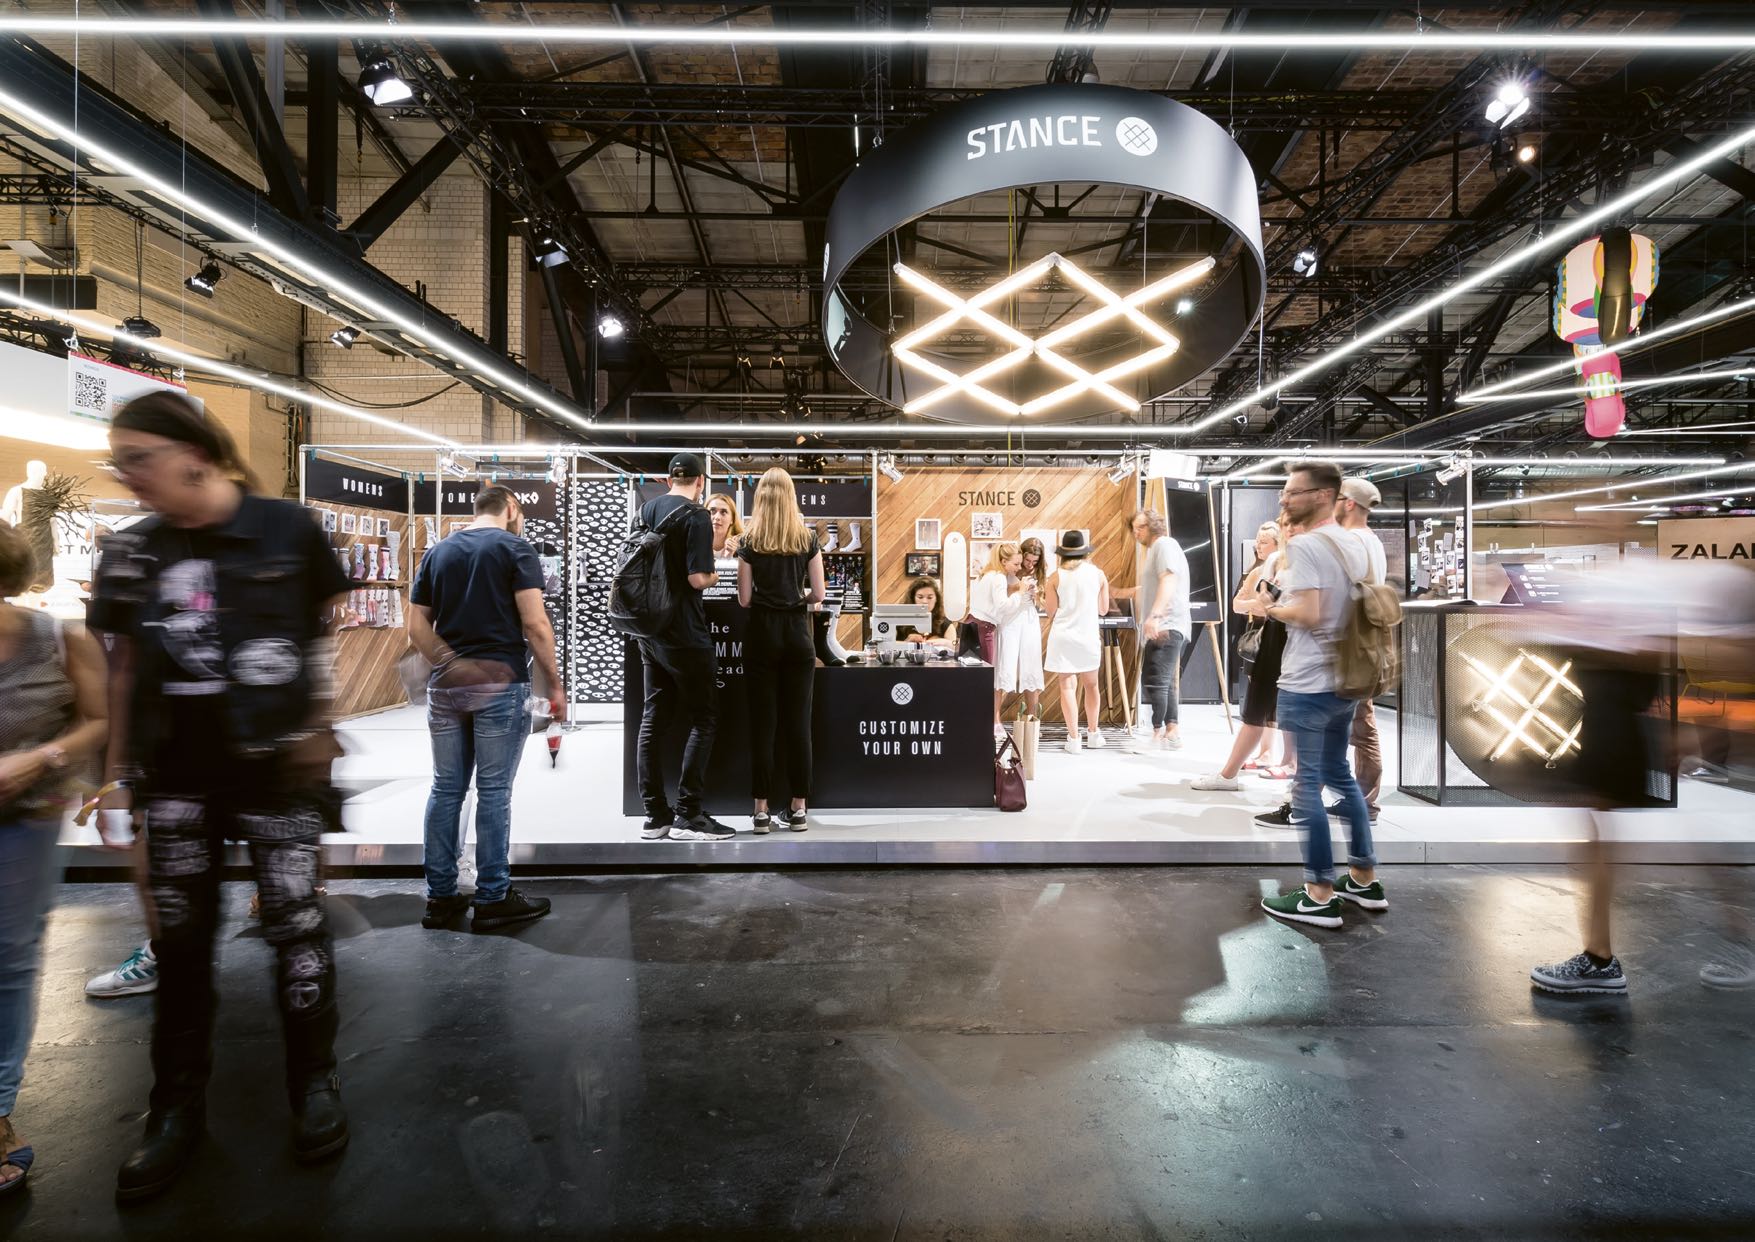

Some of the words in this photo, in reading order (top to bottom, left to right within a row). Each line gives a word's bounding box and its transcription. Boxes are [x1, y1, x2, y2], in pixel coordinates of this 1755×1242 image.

[967, 115, 1103, 161] STANCE
[342, 478, 383, 497] WOMENS
[440, 492, 475, 503] OME
[801, 494, 826, 505] ENS
[958, 491, 1016, 506] STANCE
[1671, 542, 1755, 560] ZALA
[710, 621, 730, 634] he
[715, 641, 743, 658] MM
[859, 720, 945, 735] CUSTOMIZE
[863, 740, 901, 755] YOUR
[911, 740, 942, 755] OWN
